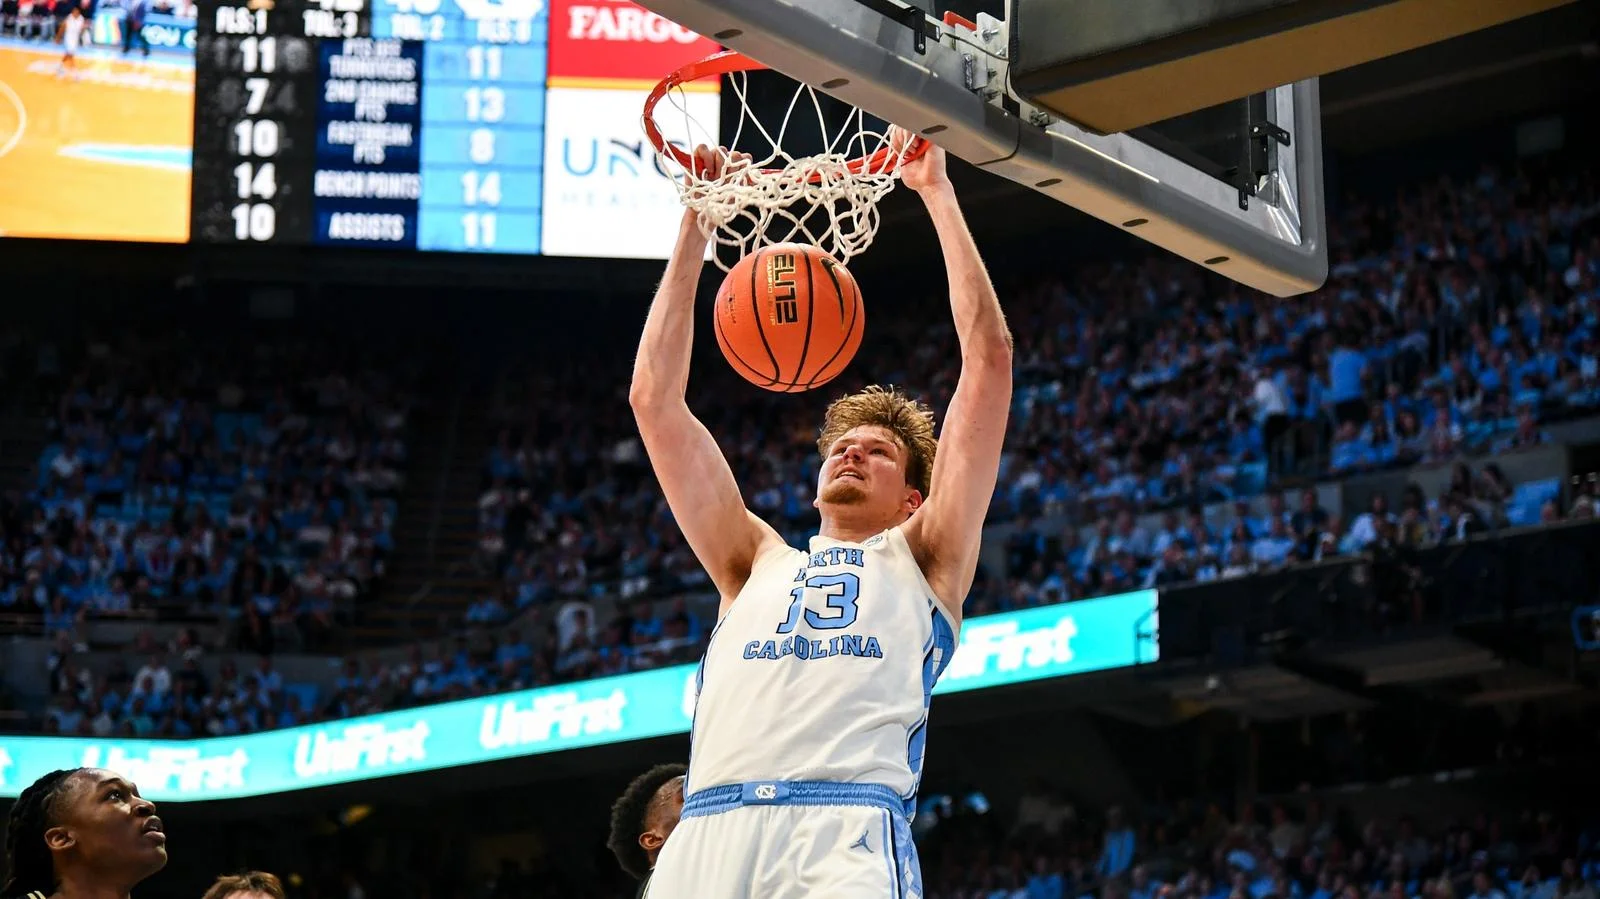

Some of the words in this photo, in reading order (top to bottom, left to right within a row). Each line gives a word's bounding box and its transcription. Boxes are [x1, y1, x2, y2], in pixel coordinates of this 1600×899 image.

[240, 36, 276, 73] 11
[466, 45, 501, 80] 11
[245, 77, 270, 114] 7
[464, 87, 506, 123] 13
[235, 119, 278, 157] 10
[563, 138, 686, 178] UNC
[234, 162, 277, 199] 14
[314, 170, 364, 197] BENCH
[366, 172, 421, 199] POINTS
[461, 170, 502, 206] 14
[231, 203, 276, 241] 10
[329, 212, 405, 241] ASSISTS
[461, 211, 497, 247] 11
[773, 253, 798, 326] ELITE
[776, 572, 860, 633] 13
[743, 634, 883, 660] CAROLINA
[479, 688, 629, 749] UniFirst
[293, 719, 430, 777] UniFirst
